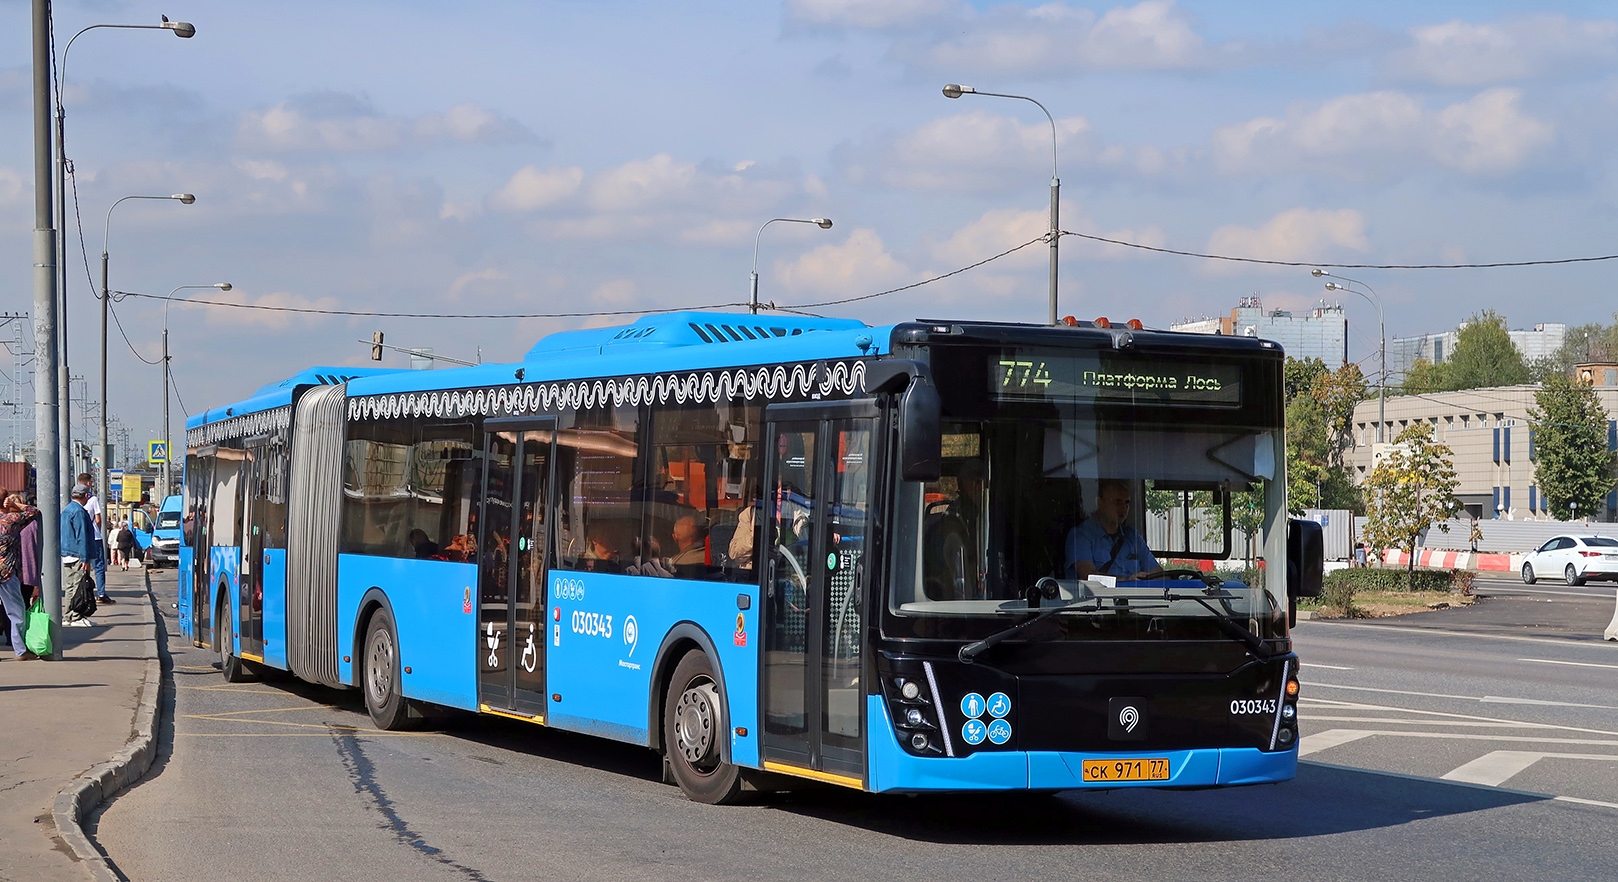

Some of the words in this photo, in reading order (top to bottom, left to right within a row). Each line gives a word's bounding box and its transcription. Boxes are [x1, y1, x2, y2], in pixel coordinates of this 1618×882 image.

[998, 360, 1053, 388] 774
[1083, 371, 1178, 390] Платформа
[1183, 375, 1222, 391] Лось
[571, 610, 613, 639] 030343
[1230, 699, 1276, 715] 030343
[1090, 765, 1108, 779] СК
[1114, 761, 1142, 778] 971
[1150, 760, 1164, 773] 77
